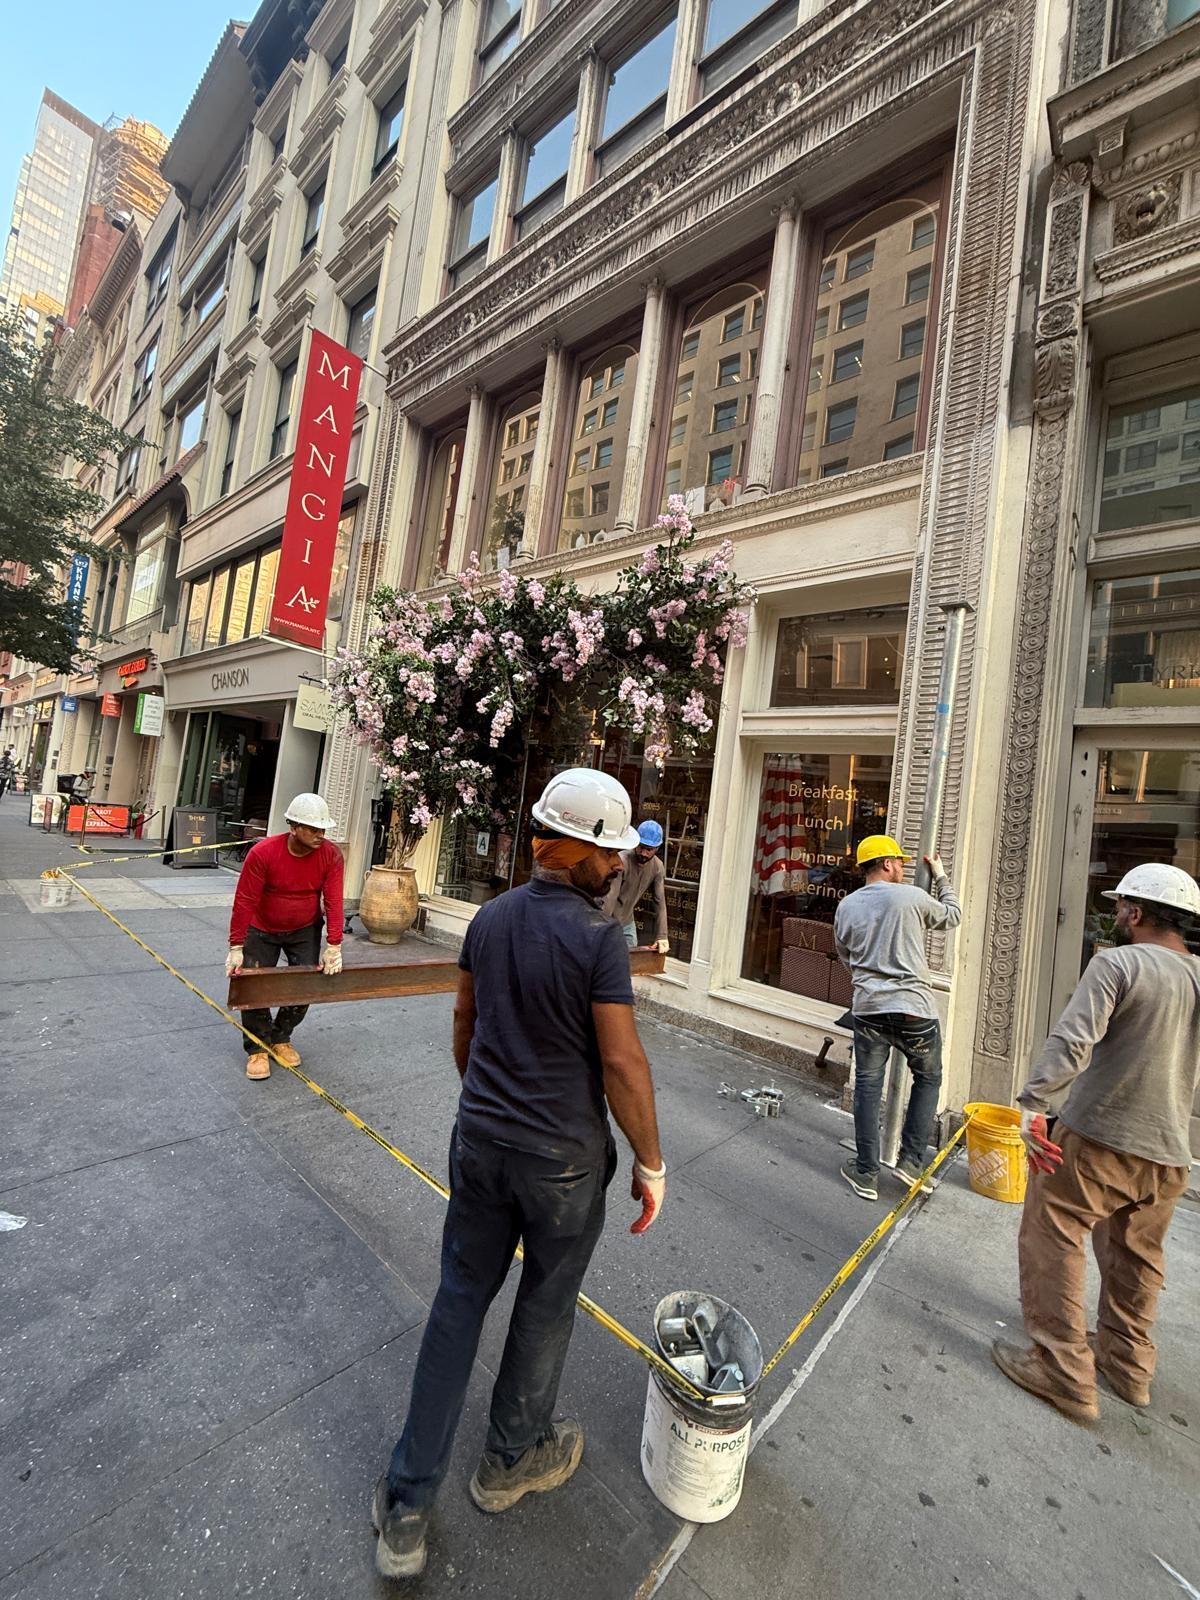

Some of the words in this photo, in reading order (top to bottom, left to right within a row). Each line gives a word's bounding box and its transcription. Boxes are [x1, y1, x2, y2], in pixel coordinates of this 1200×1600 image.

[284, 349, 352, 614] MANGIA
[211, 667, 250, 691] CHANSON
[788, 783, 859, 801] Breakfast
[797, 814, 844, 831] Lunch
[478, 836, 487, 851] A
[791, 848, 845, 867] Dinner
[799, 931, 817, 950] M
[671, 1422, 692, 1446] ALL
[694, 1430, 747, 1454] PRPOSE
